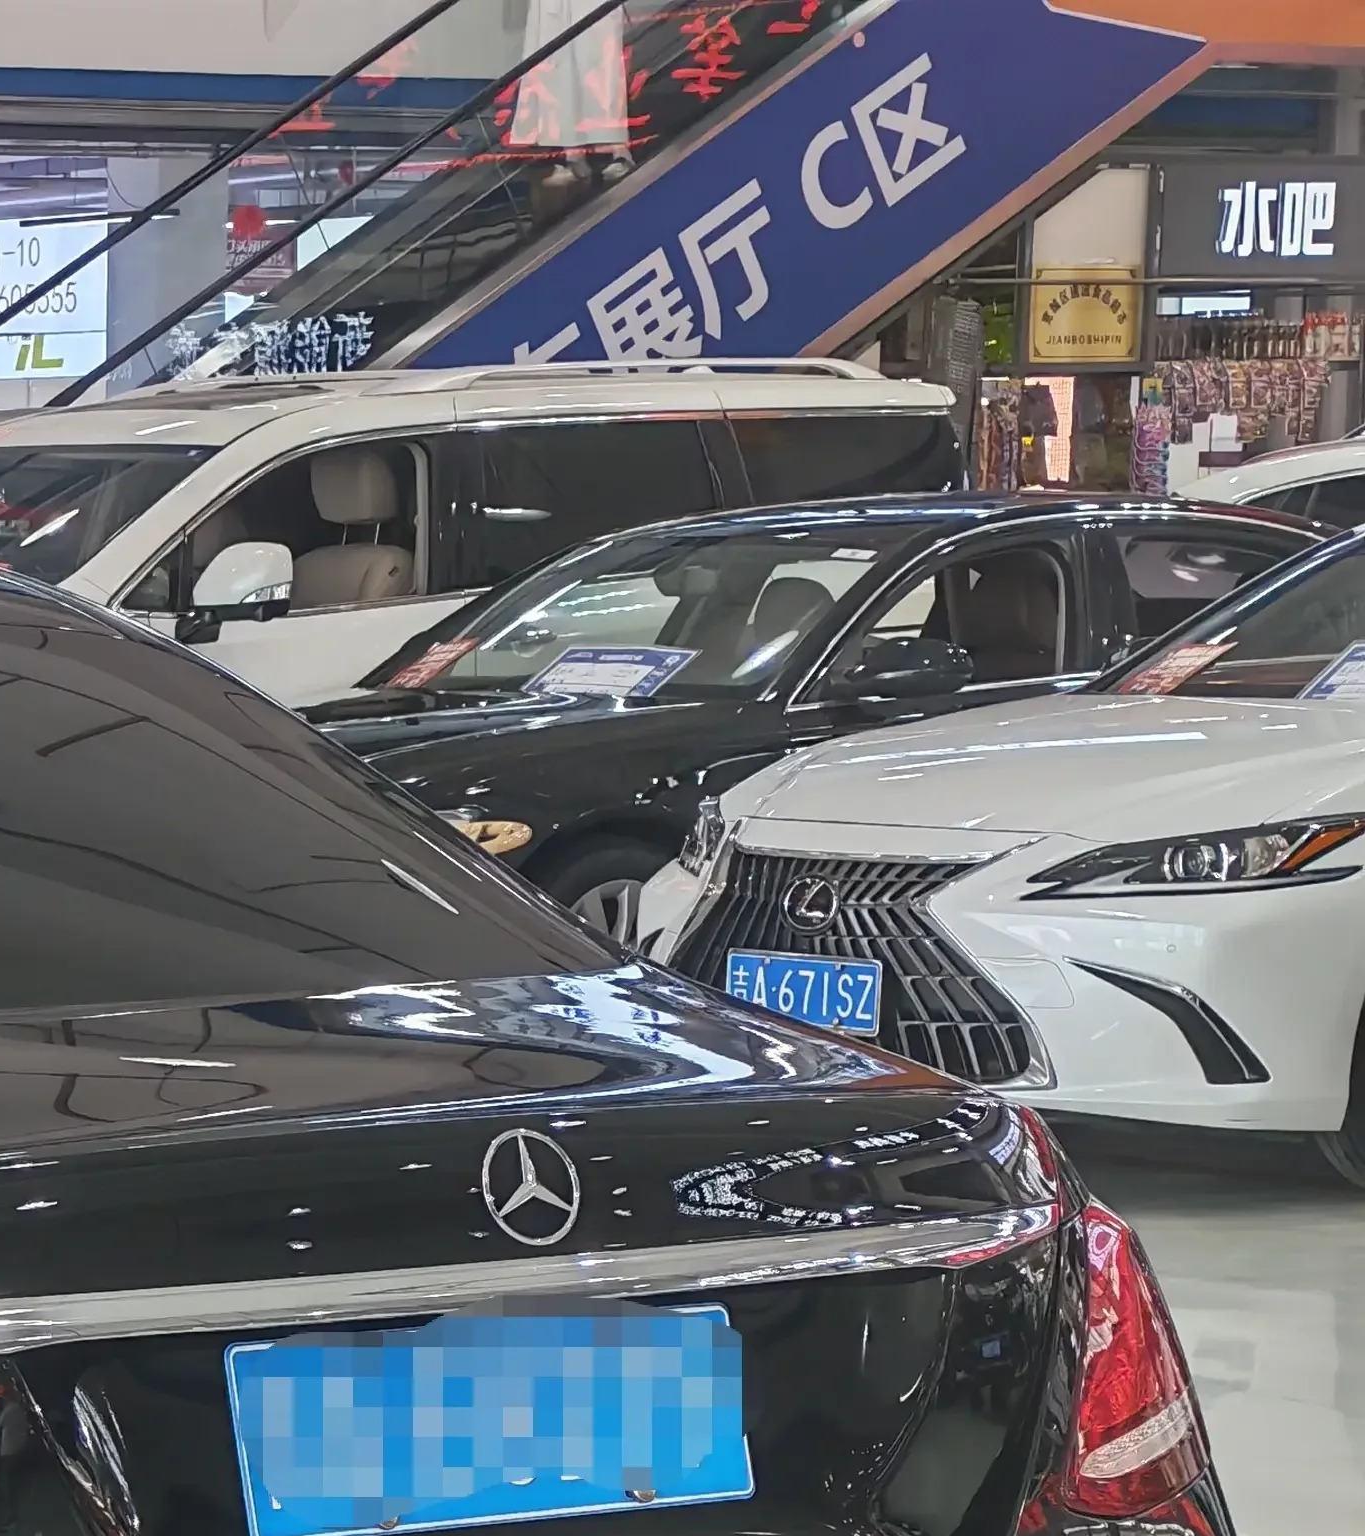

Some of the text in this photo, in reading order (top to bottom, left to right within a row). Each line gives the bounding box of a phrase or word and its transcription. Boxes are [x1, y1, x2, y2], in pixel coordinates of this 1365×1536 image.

[514, 178, 771, 374] 展厅
[801, 52, 967, 229] C区
[1218, 181, 1336, 257] 水吧
